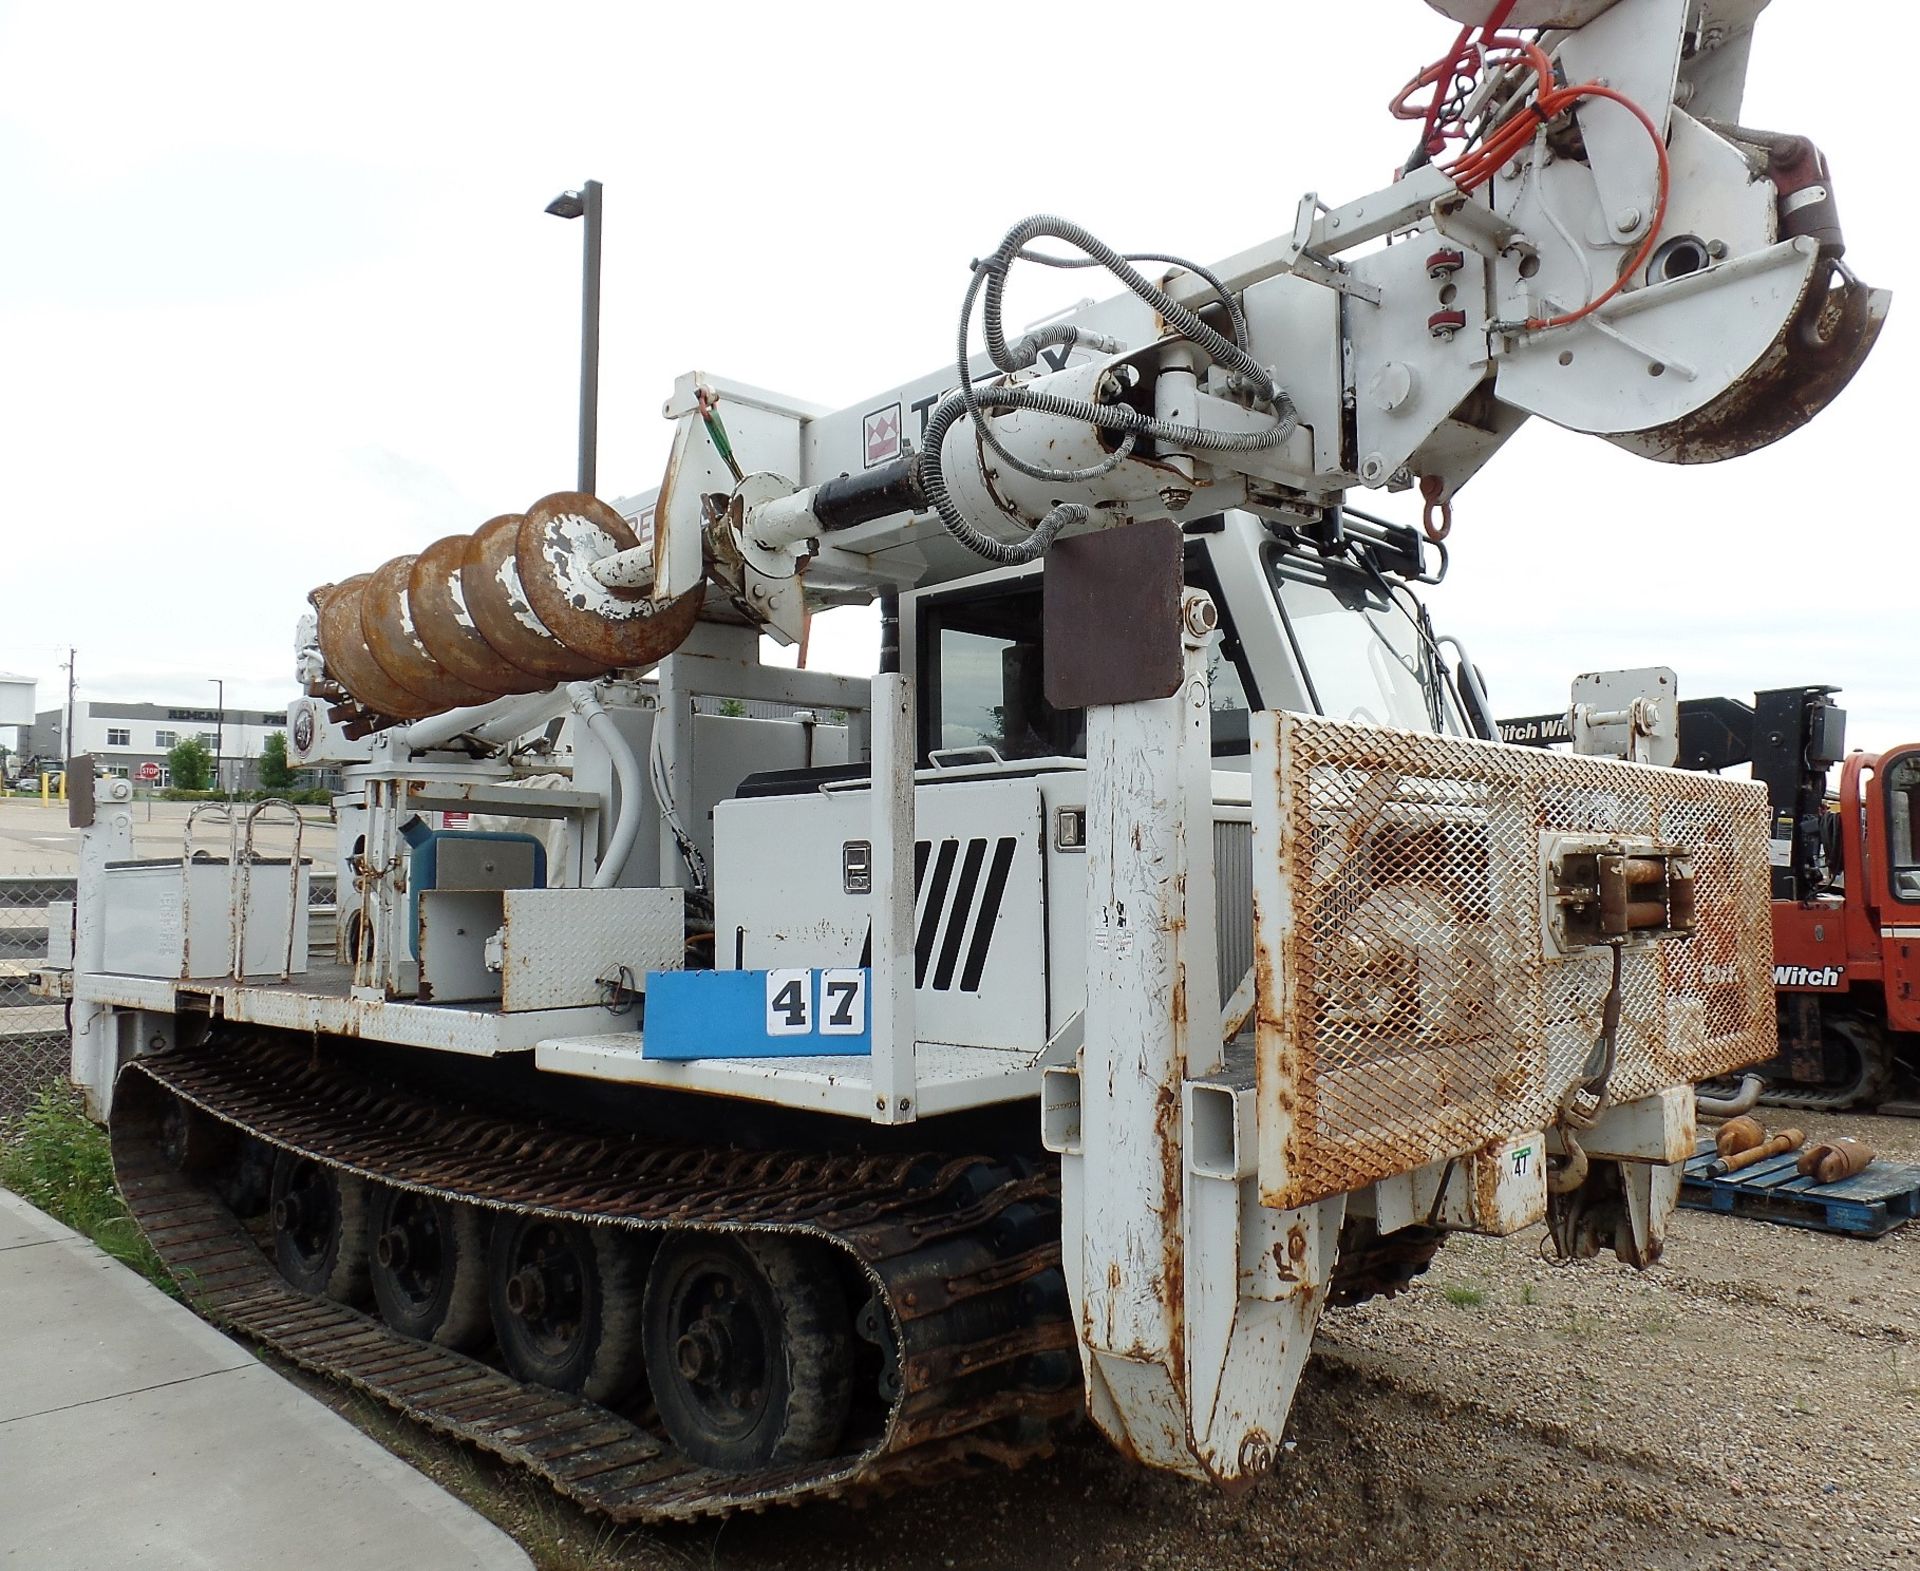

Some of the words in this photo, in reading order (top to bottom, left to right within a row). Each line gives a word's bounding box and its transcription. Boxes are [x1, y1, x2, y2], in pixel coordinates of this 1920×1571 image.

[142, 767, 158, 775] STOP
[771, 980, 858, 1026] 47
[1514, 1154, 1527, 1177] 47
